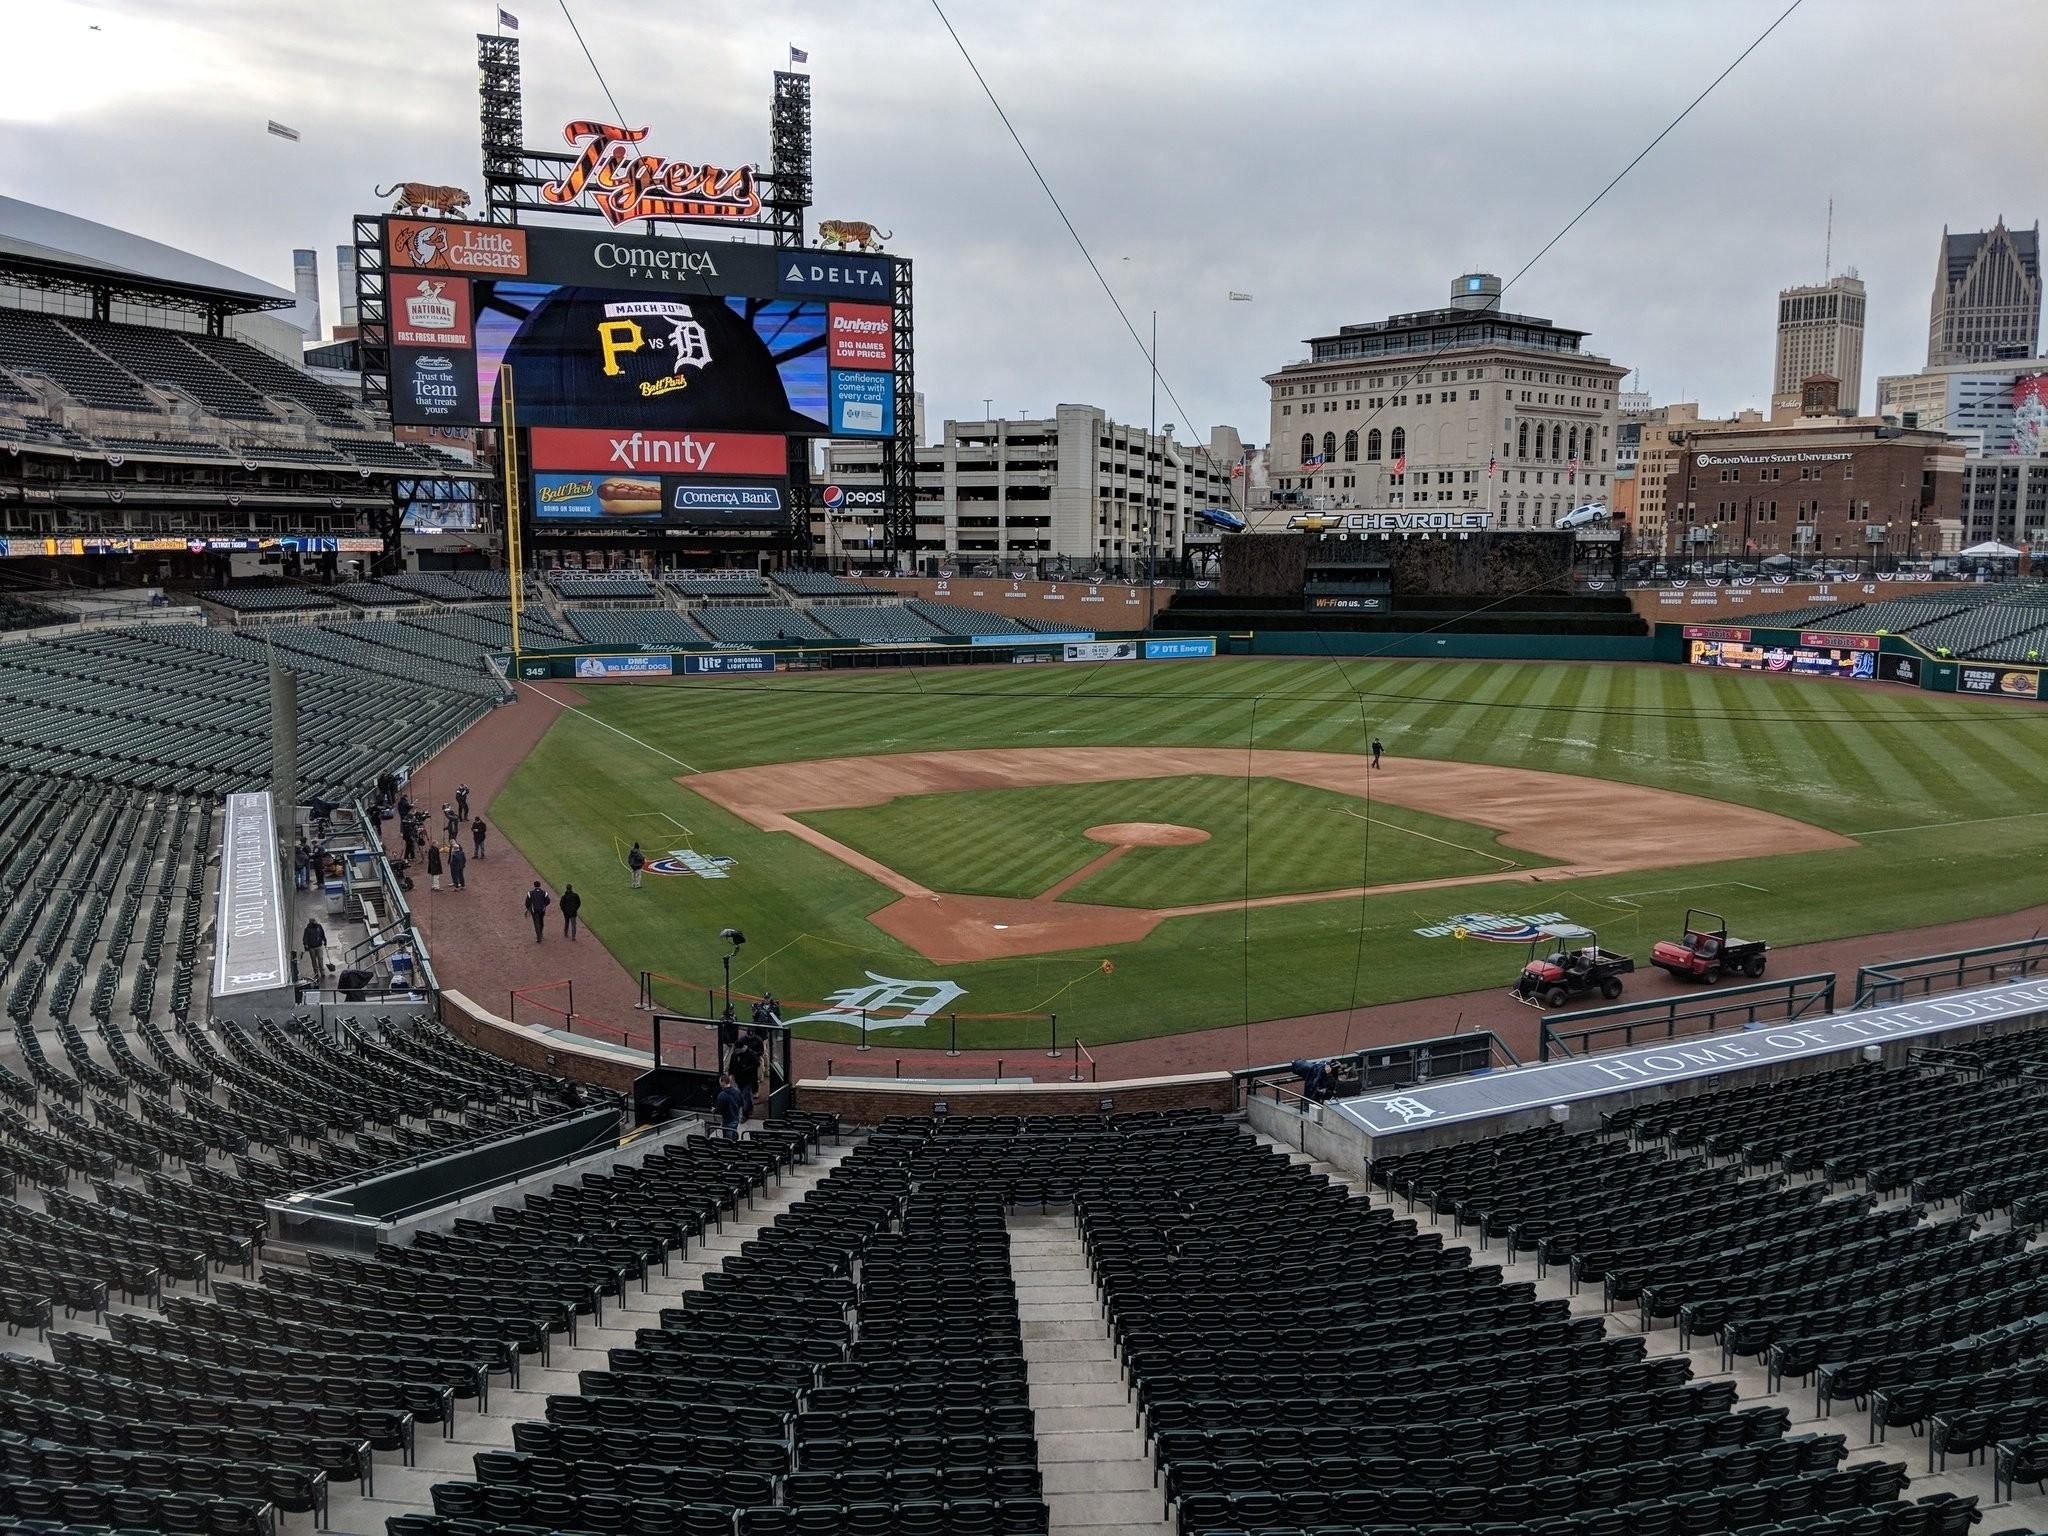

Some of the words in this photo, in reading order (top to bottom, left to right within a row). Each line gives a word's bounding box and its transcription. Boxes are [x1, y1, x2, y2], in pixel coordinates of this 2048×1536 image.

[541, 119, 762, 230] Tigers
[463, 230, 513, 253] Little
[449, 245, 520, 269] Caesars
[629, 267, 687, 282] PARK
[811, 266, 884, 286] DELTA
[411, 305, 452, 316] NATIONAL
[616, 305, 657, 314] MARCH
[833, 316, 889, 333] Dunham's
[398, 331, 415, 342] FAST.
[415, 333, 437, 343] FRESH.
[437, 334, 467, 344] FRIENDLY.
[597, 319, 645, 376] P
[647, 338, 664, 350] VS
[838, 341, 853, 349] BIG
[855, 342, 884, 351] NAMES
[837, 350, 855, 358] LOW
[857, 351, 886, 360] PRICES
[416, 372, 437, 381] Trust
[440, 373, 453, 382] the
[838, 373, 885, 385] Confidence
[413, 380, 457, 397] Team
[838, 384, 865, 392] comes
[867, 384, 885, 393] with
[416, 397, 431, 405] that
[434, 398, 457, 406] treats
[838, 393, 861, 402] every
[425, 407, 448, 415] yours
[609, 432, 715, 470] xfinity
[1709, 455, 1740, 465] GRAND
[1739, 455, 1770, 464] VALLEY
[1771, 454, 1797, 463] STATE
[1798, 452, 1853, 461] UNIVERSITY
[539, 486, 566, 503] Ball
[567, 481, 594, 500] Park
[845, 490, 886, 505] pepsi
[742, 492, 772, 504] Bank
[560, 505, 568, 513] ON
[1347, 513, 1493, 529] CHEVROLET
[937, 581, 947, 589] 23
[1013, 582, 1019, 591] 5
[1051, 585, 1056, 593] 2
[1819, 585, 1827, 594] 11
[1862, 584, 1876, 594] 42
[1089, 587, 1097, 595] 16
[1130, 589, 1136, 598] 6
[1316, 599, 1337, 607] Wi-Fi
[1348, 599, 1360, 607] us.
[1162, 645, 1178, 653] DTE
[1180, 644, 1208, 653] Energy
[698, 657, 721, 671] Lite
[526, 667, 546, 676] 345'
[1964, 670, 1995, 679] FRESH
[1966, 682, 1991, 690] FAST
[237, 815, 262, 834] HOME
[237, 835, 260, 845] OF
[237, 845, 260, 860] THE
[236, 861, 265, 898] DETROIT
[234, 899, 267, 937] TIGERS
[1594, 1043, 1759, 1080] HOME
[1765, 1029, 1833, 1050] OF
[1831, 1012, 1932, 1035] THE
